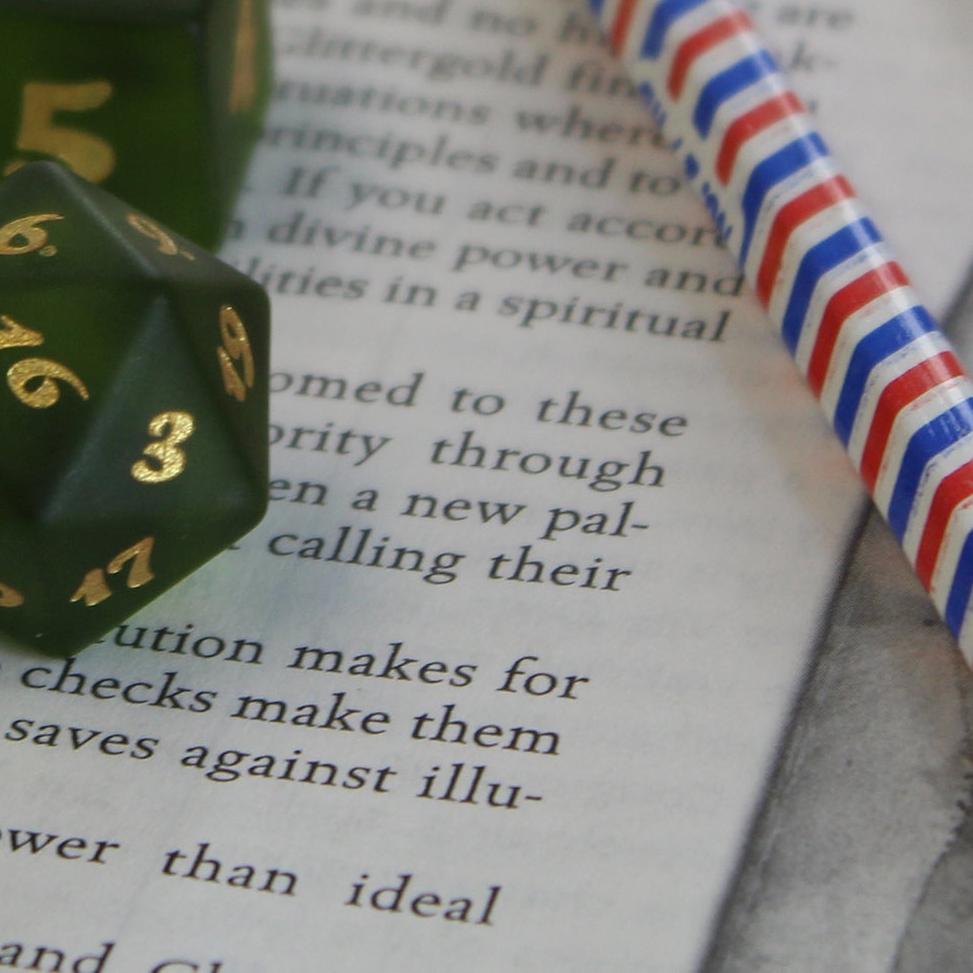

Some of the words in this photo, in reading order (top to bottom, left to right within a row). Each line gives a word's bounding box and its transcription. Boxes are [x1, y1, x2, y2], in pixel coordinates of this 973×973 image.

[263, 124, 501, 176] rinciples
[512, 156, 617, 191] and
[281, 164, 341, 199] If
[346, 179, 447, 217] you
[467, 196, 547, 226] act
[267, 209, 439, 260] divine
[449, 241, 632, 284] power
[643, 265, 747, 298] and
[382, 274, 439, 307] in
[454, 289, 481, 313] a
[498, 290, 732, 344] spiritual
[269, 370, 424, 408] omed
[449, 386, 506, 416] to
[536, 390, 690, 438] these
[131, 411, 196, 484] 3
[269, 421, 394, 468] ority
[428, 429, 668, 494] through
[351, 486, 379, 513] a
[400, 490, 529, 527] new
[538, 500, 651, 542] pal-
[267, 526, 466, 585] calling
[486, 545, 633, 592] their
[286, 640, 478, 689] makes
[495, 654, 591, 701] for
[20, 657, 218, 714] checks
[230, 691, 393, 736] make
[411, 702, 562, 757] them
[4, 715, 161, 760] saves
[179, 744, 398, 795] against
[414, 761, 545, 810] illu-
[161, 842, 299, 897] than
[343, 872, 503, 927] ideal
